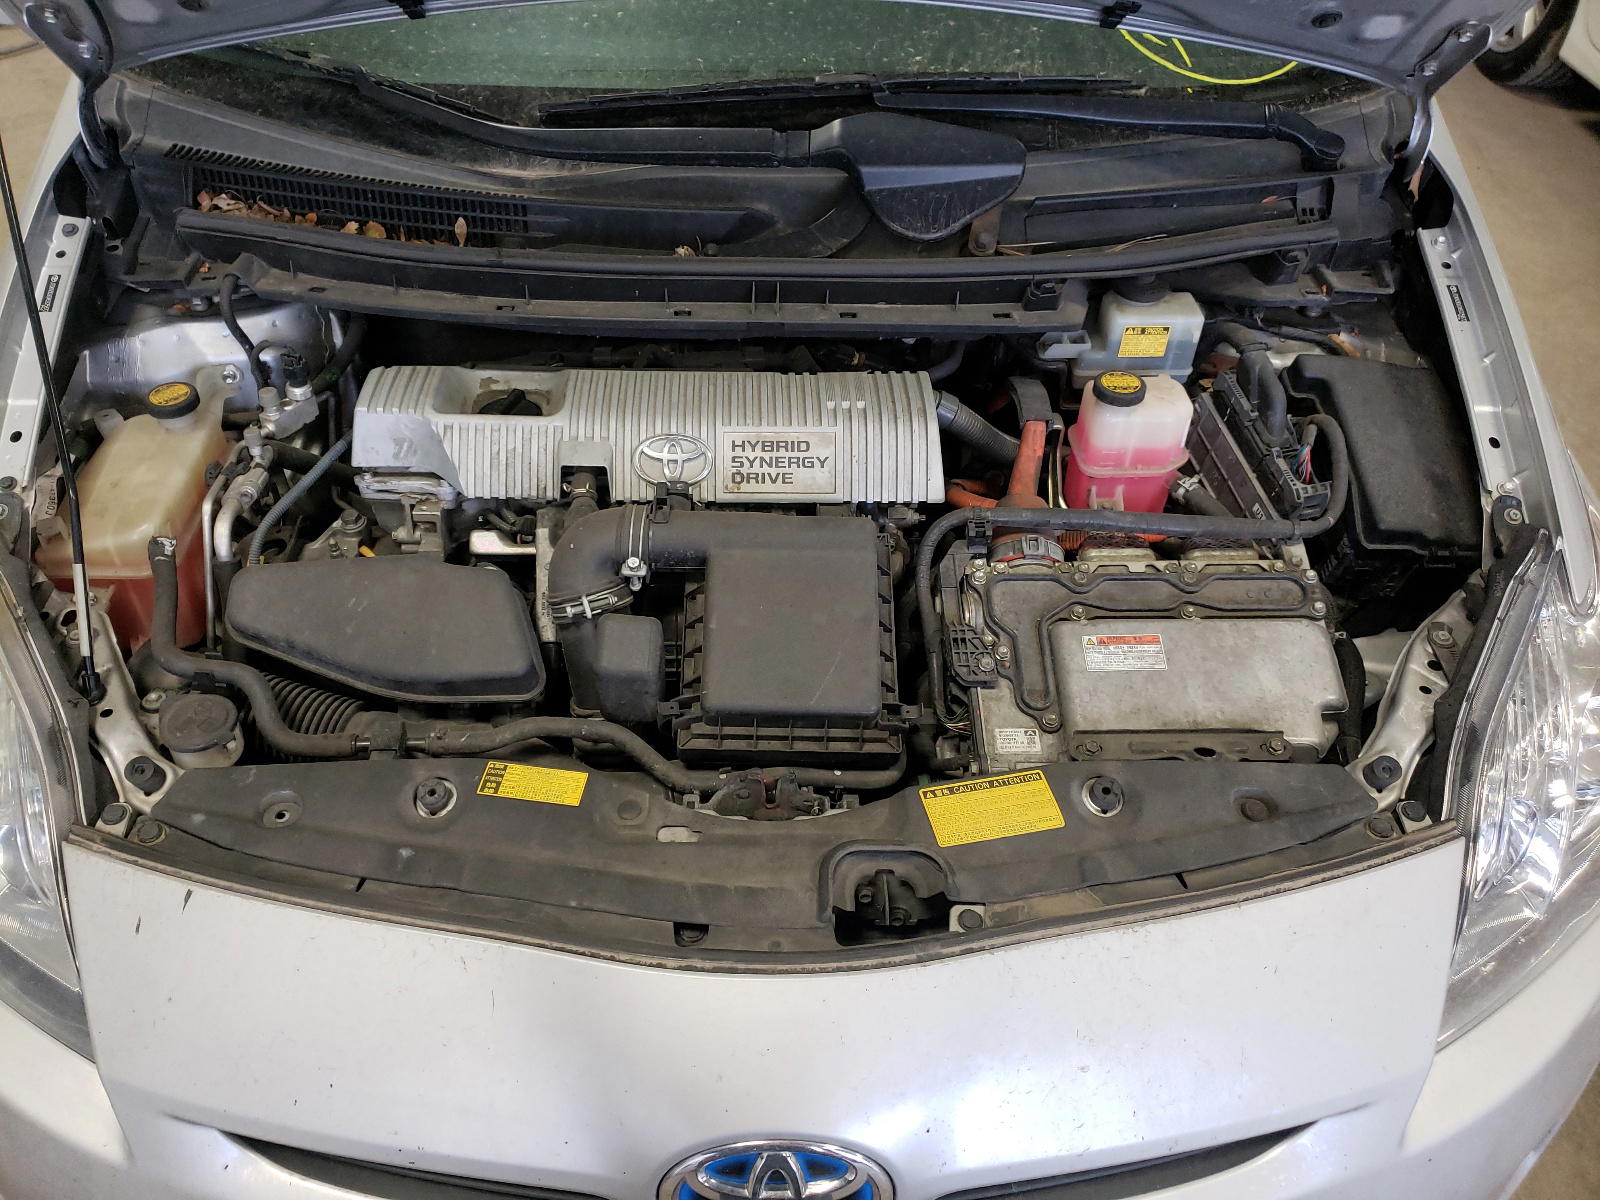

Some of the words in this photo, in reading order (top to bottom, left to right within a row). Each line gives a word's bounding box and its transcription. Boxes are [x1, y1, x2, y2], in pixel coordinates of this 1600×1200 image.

[731, 440, 811, 453] HYBRID
[731, 456, 830, 469] SYNERGY
[731, 472, 794, 485] DRIVE
[953, 781, 990, 794] CAUTION
[993, 773, 1041, 788] ATTENTION
